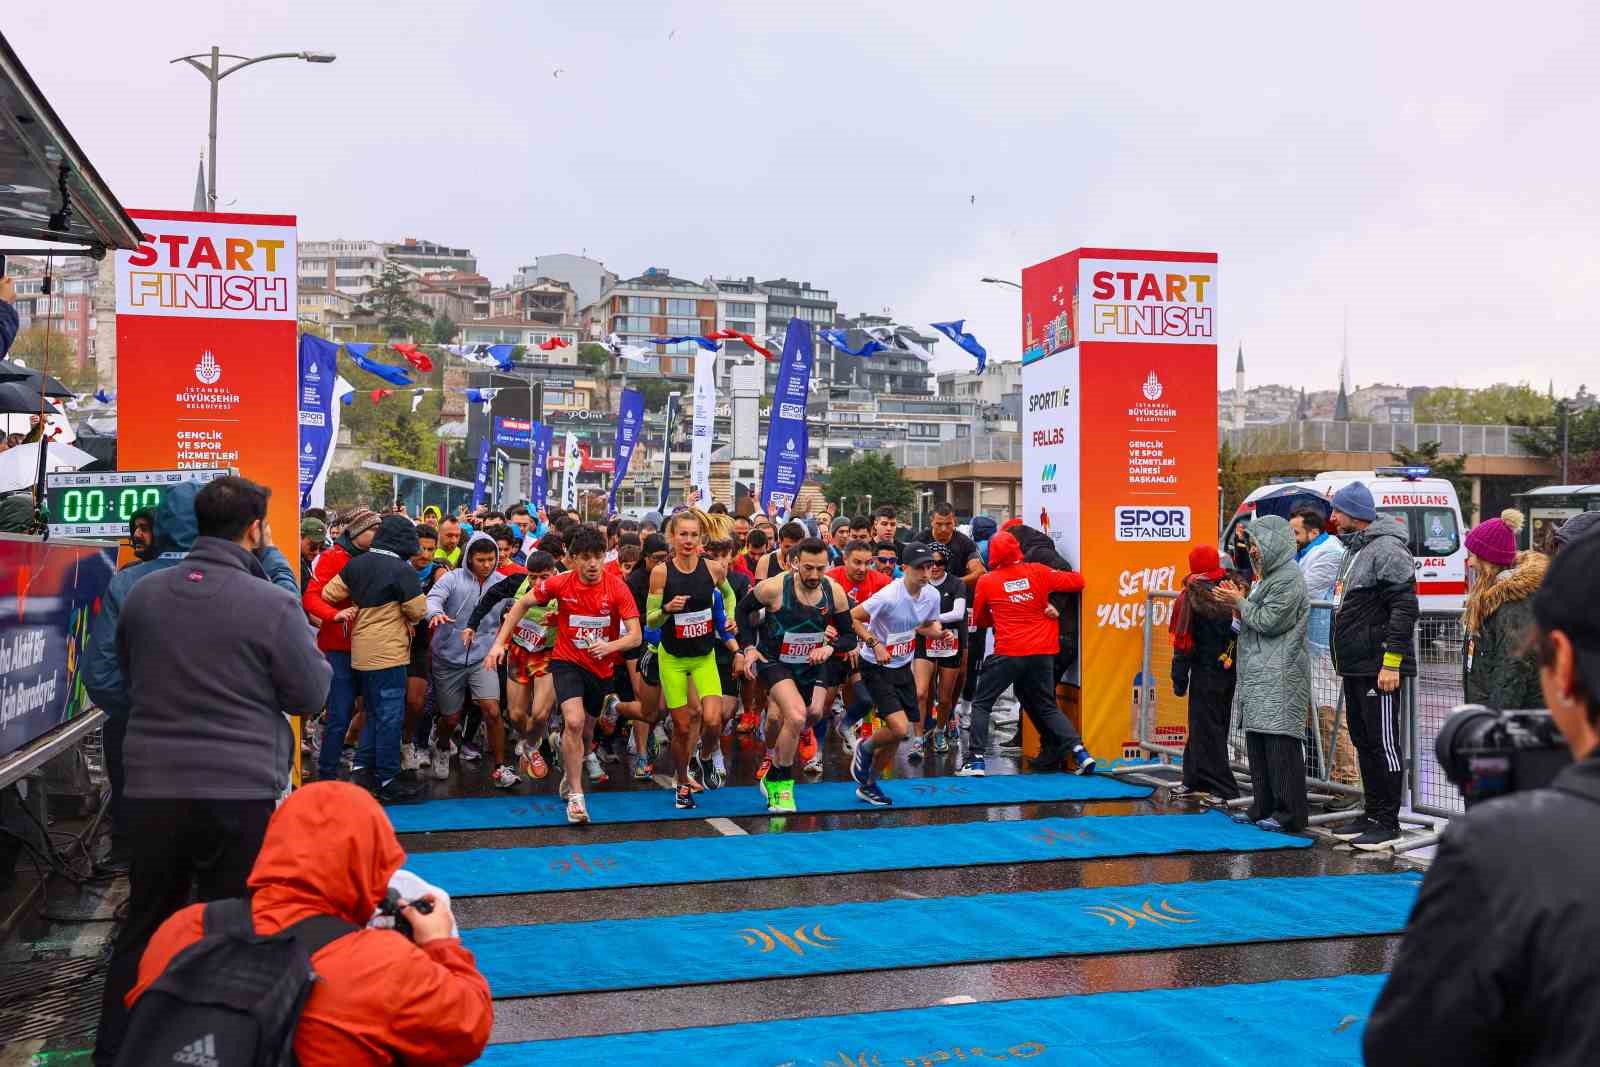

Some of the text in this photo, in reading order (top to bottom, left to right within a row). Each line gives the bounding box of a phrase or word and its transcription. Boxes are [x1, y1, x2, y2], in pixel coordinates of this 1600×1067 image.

[128, 232, 285, 272] START
[130, 271, 288, 311] FINISH
[1092, 271, 1210, 302] START
[1093, 304, 1212, 336] FINISH
[177, 430, 223, 441] GENÇLİK
[1129, 440, 1164, 449] GENÇLİK
[177, 450, 239, 460] HİZMETLERİ
[1141, 449, 1163, 457] SPOR
[1382, 495, 1449, 505] AMBULANS
[1120, 510, 1185, 526] SPOR
[518, 629, 541, 646] 4097
